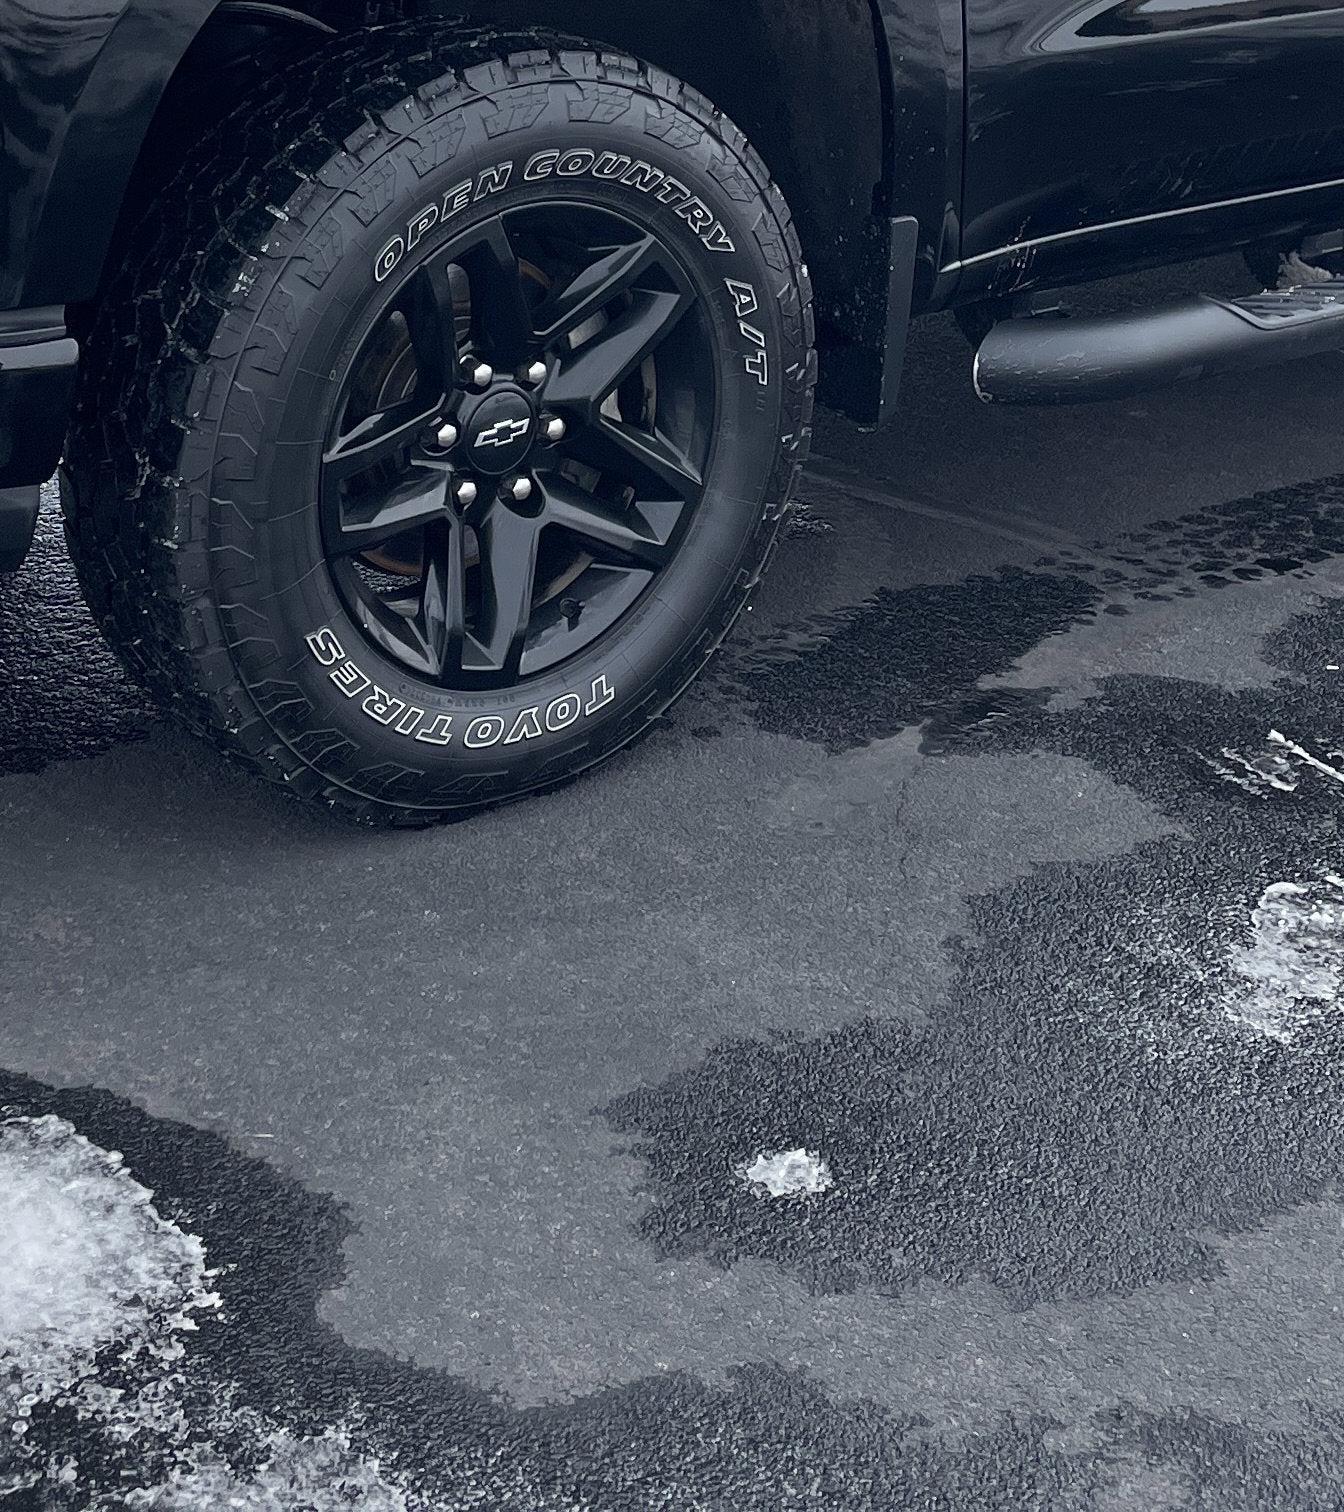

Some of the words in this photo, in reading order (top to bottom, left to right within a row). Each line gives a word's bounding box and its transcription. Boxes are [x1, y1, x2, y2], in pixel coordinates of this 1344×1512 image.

[374, 161, 510, 282] OPEN
[523, 148, 736, 254] COUNTRY
[723, 276, 768, 386] A/T
[304, 626, 453, 746] TIRES
[464, 674, 615, 749] TOYO
